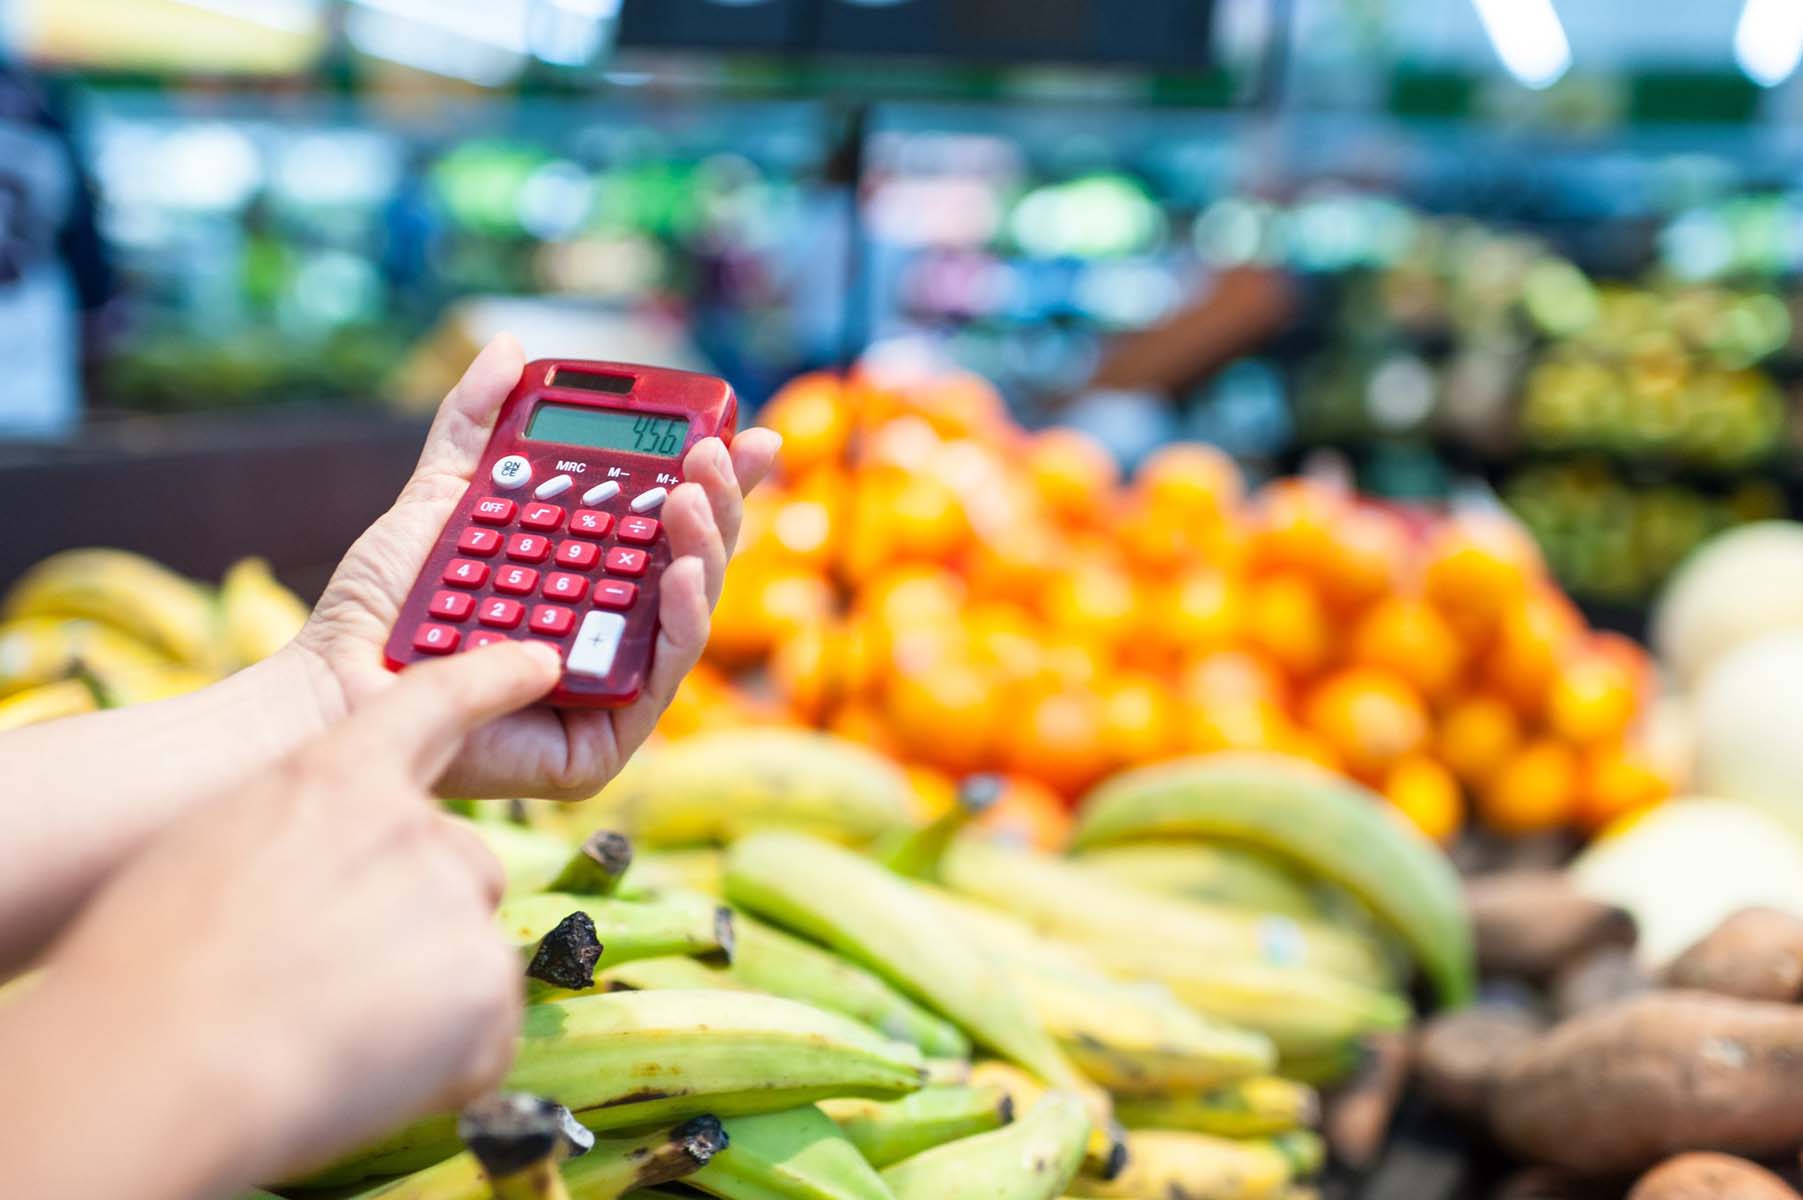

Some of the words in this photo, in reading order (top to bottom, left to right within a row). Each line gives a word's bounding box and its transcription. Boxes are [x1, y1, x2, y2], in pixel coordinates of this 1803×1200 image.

[556, 460, 587, 473] MRC
[656, 473, 679, 485] M+
[480, 501, 504, 513] OFF
[471, 532, 485, 544] 7
[519, 539, 533, 552] 8
[568, 545, 582, 558] 9
[456, 564, 470, 577] 4
[508, 570, 523, 584] 5
[556, 577, 569, 591] 6
[445, 596, 456, 609] 1
[490, 602, 505, 616] 2
[542, 609, 556, 624] 3
[427, 628, 442, 642] 0
